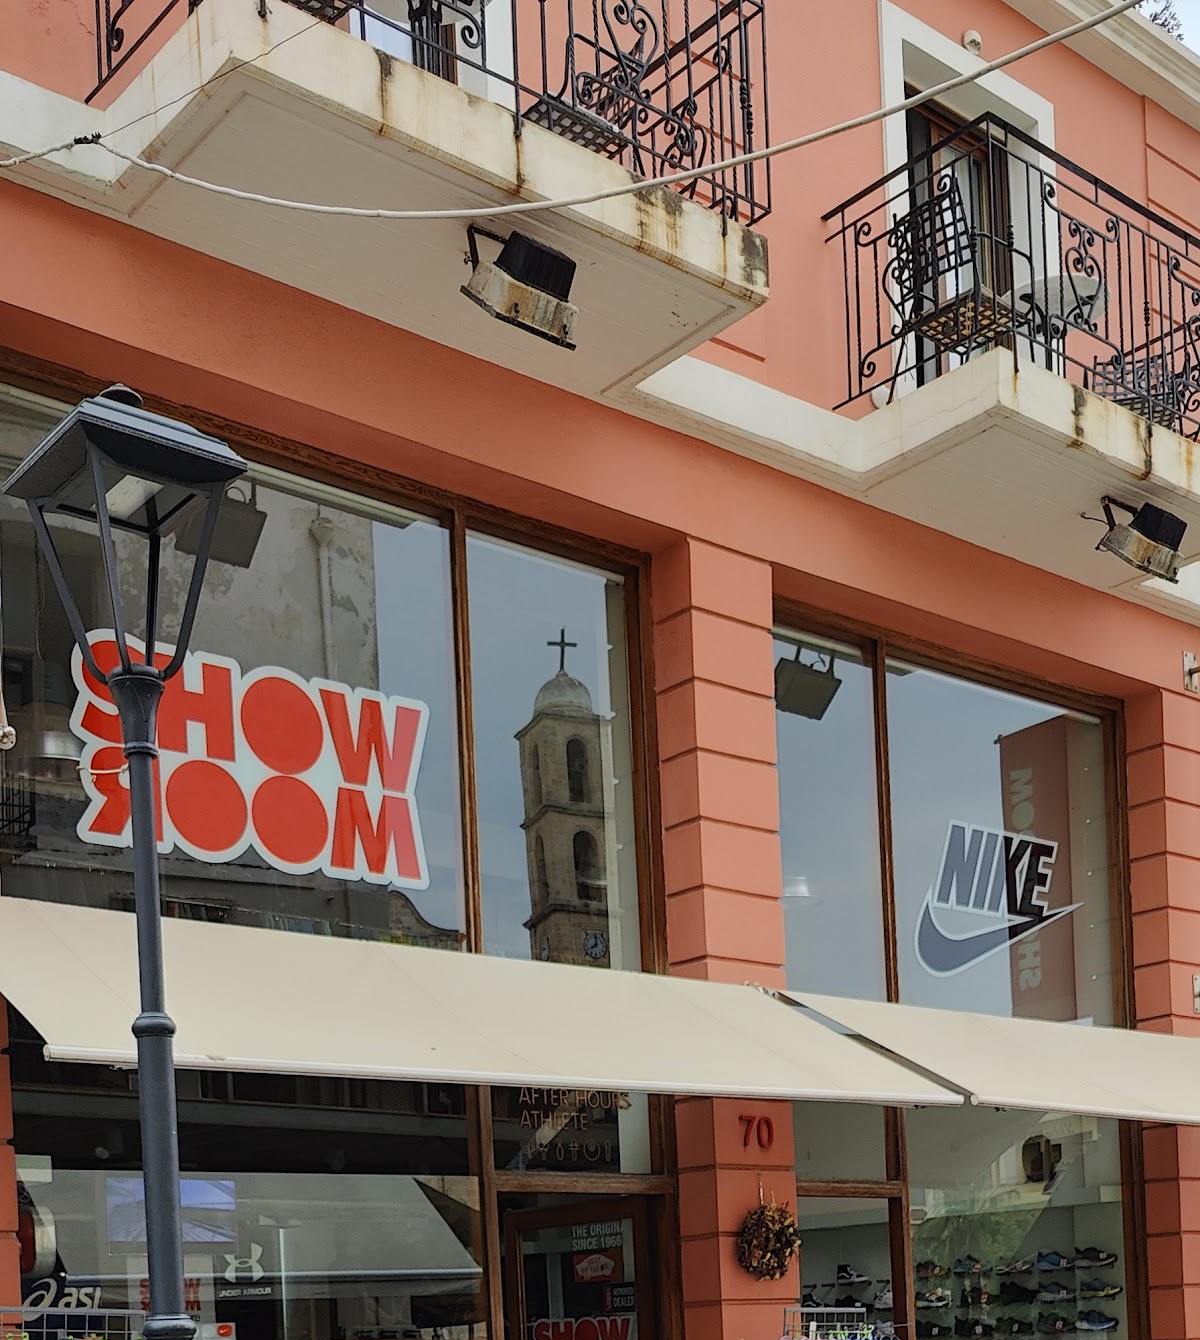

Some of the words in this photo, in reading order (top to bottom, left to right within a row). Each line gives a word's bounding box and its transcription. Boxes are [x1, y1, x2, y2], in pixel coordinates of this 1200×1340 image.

[80, 640, 422, 793] SHOW
[935, 822, 1057, 920] NIKE
[519, 1087, 569, 1106] AFTER
[520, 1109, 588, 1131] ATHLETE
[738, 1115, 774, 1149] 70
[572, 1225, 589, 1238] THE
[572, 1237, 598, 1251] SINCE
[600, 1234, 623, 1248] 1966
[243, 1287, 272, 1297] ARMOUR
